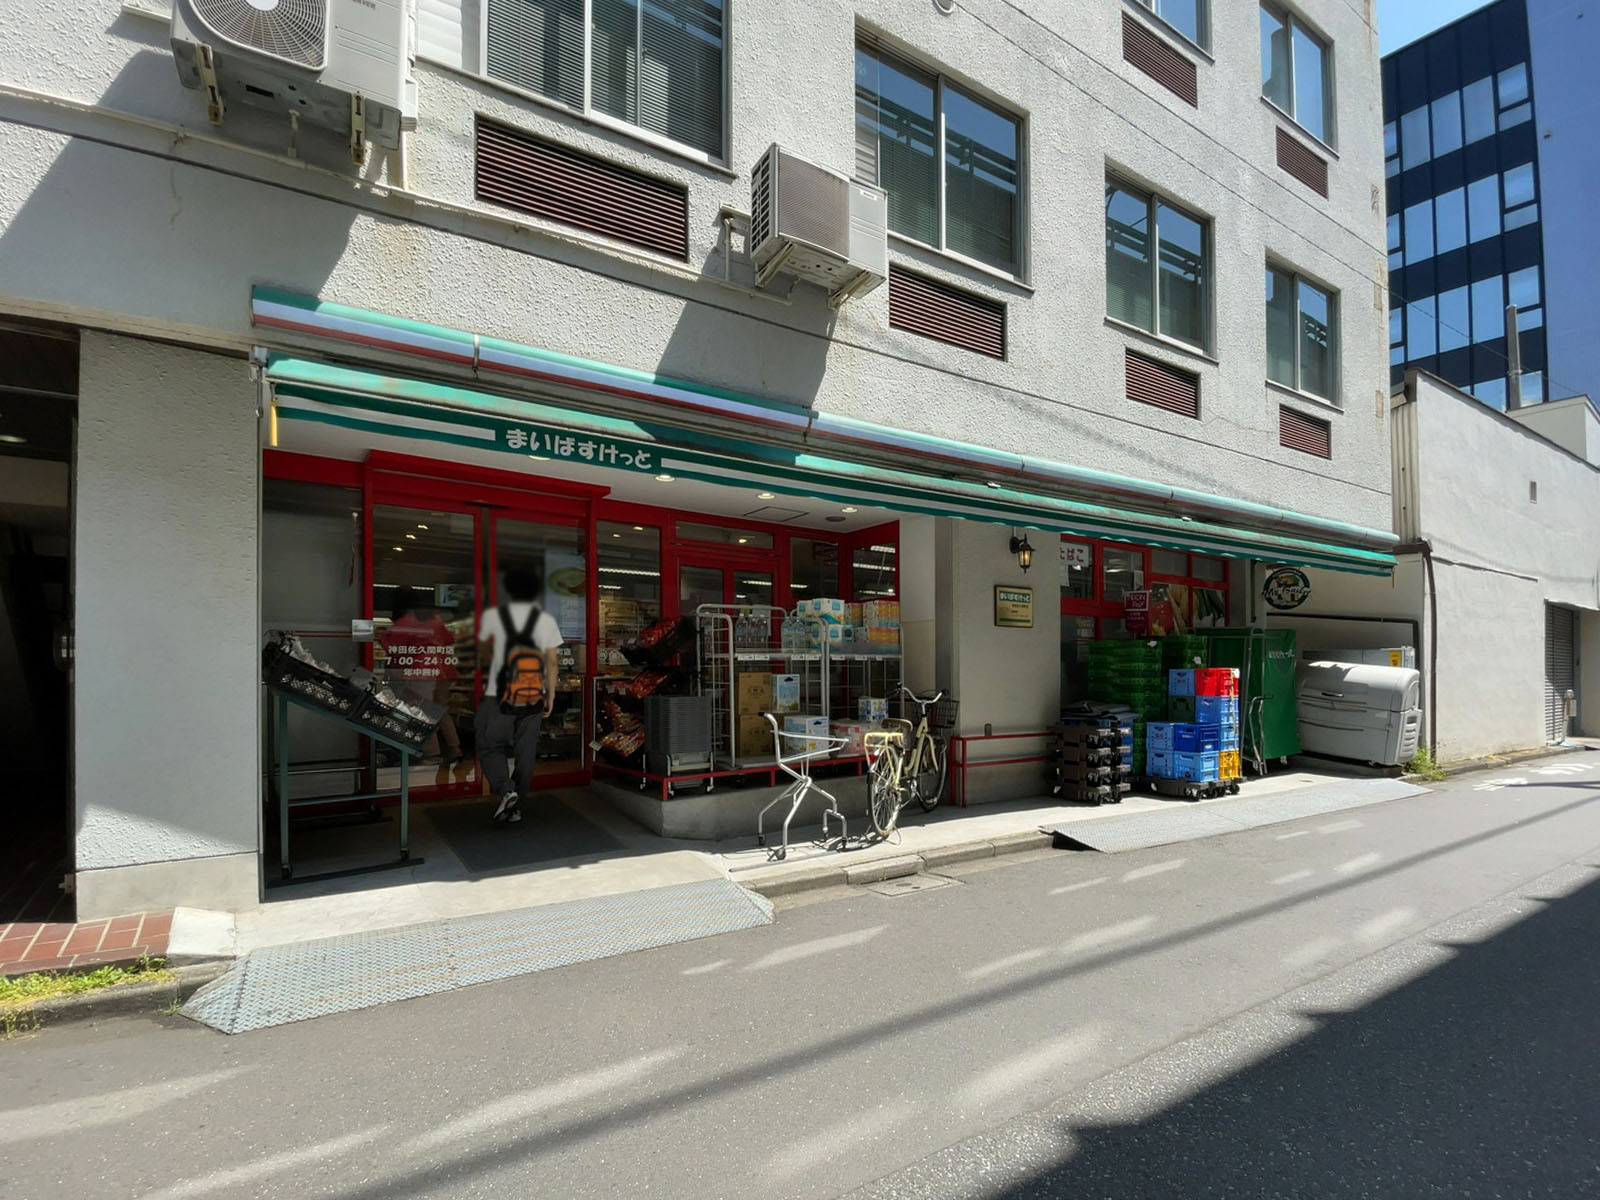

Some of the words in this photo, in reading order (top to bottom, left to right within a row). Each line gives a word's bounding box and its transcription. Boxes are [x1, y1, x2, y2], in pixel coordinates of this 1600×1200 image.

[506, 429, 651, 469] まいばすけっと
[388, 645, 455, 654] 神田佐久間町店
